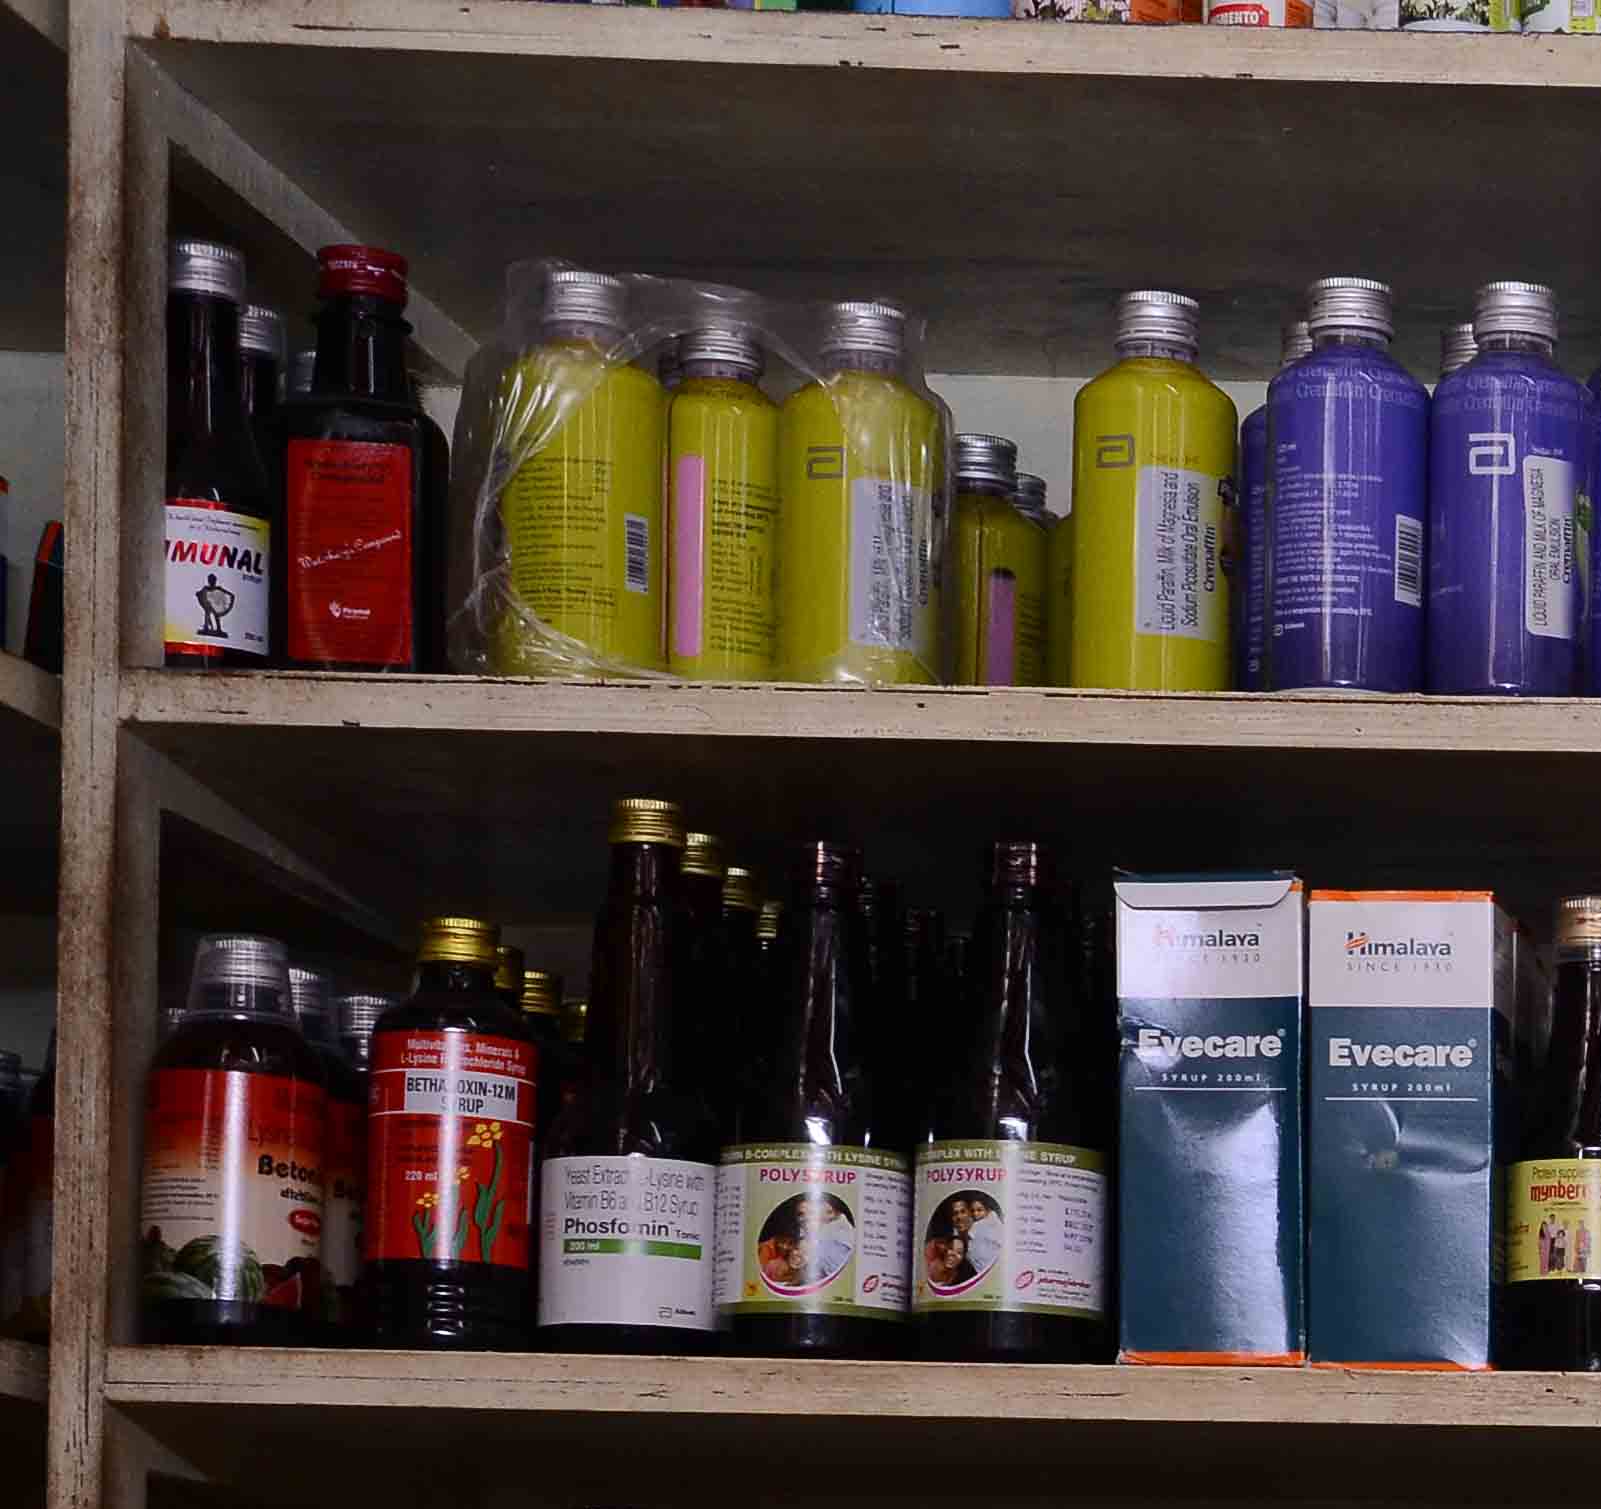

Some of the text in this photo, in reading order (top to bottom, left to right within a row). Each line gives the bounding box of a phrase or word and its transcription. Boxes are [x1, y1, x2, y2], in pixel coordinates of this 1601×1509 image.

[1344, 931, 1451, 956] Himalaya
[1138, 1028, 1283, 1058] Evecare
[1328, 1037, 1473, 1067] Evecare
[1161, 1072, 1261, 1082] SYRUP 200ml
[1352, 1082, 1452, 1092] SYRUP 200ml
[406, 1076, 516, 1102] BETHAOXIN-12M
[440, 1095, 485, 1114] SRUP
[926, 1168, 1008, 1186] POLYSYRUP
